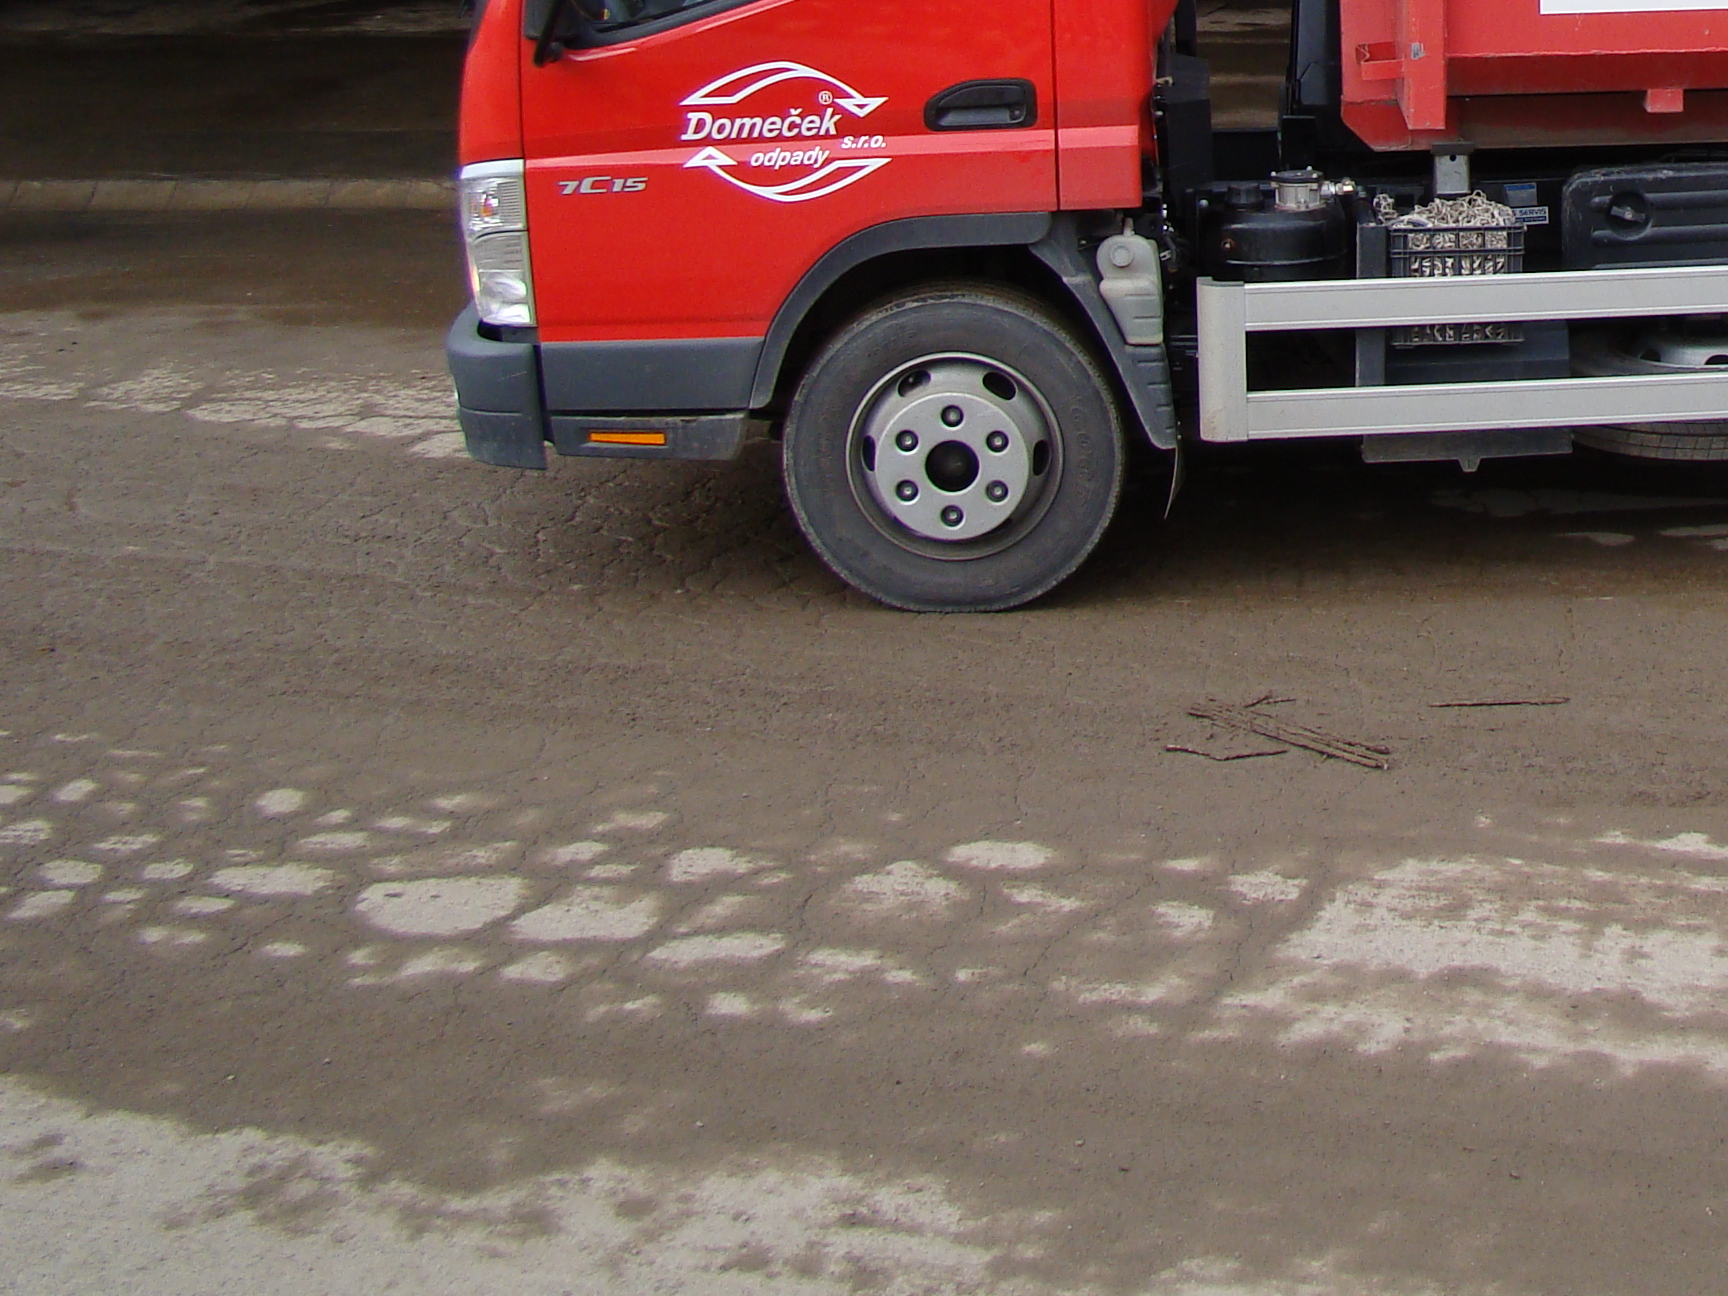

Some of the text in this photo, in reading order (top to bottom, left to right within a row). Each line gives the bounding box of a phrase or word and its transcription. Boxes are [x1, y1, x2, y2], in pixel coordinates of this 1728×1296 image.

[680, 107, 842, 141] Domeček
[841, 133, 887, 149] s.r.o.
[750, 146, 830, 169] odpady
[558, 176, 648, 195] 7C15
